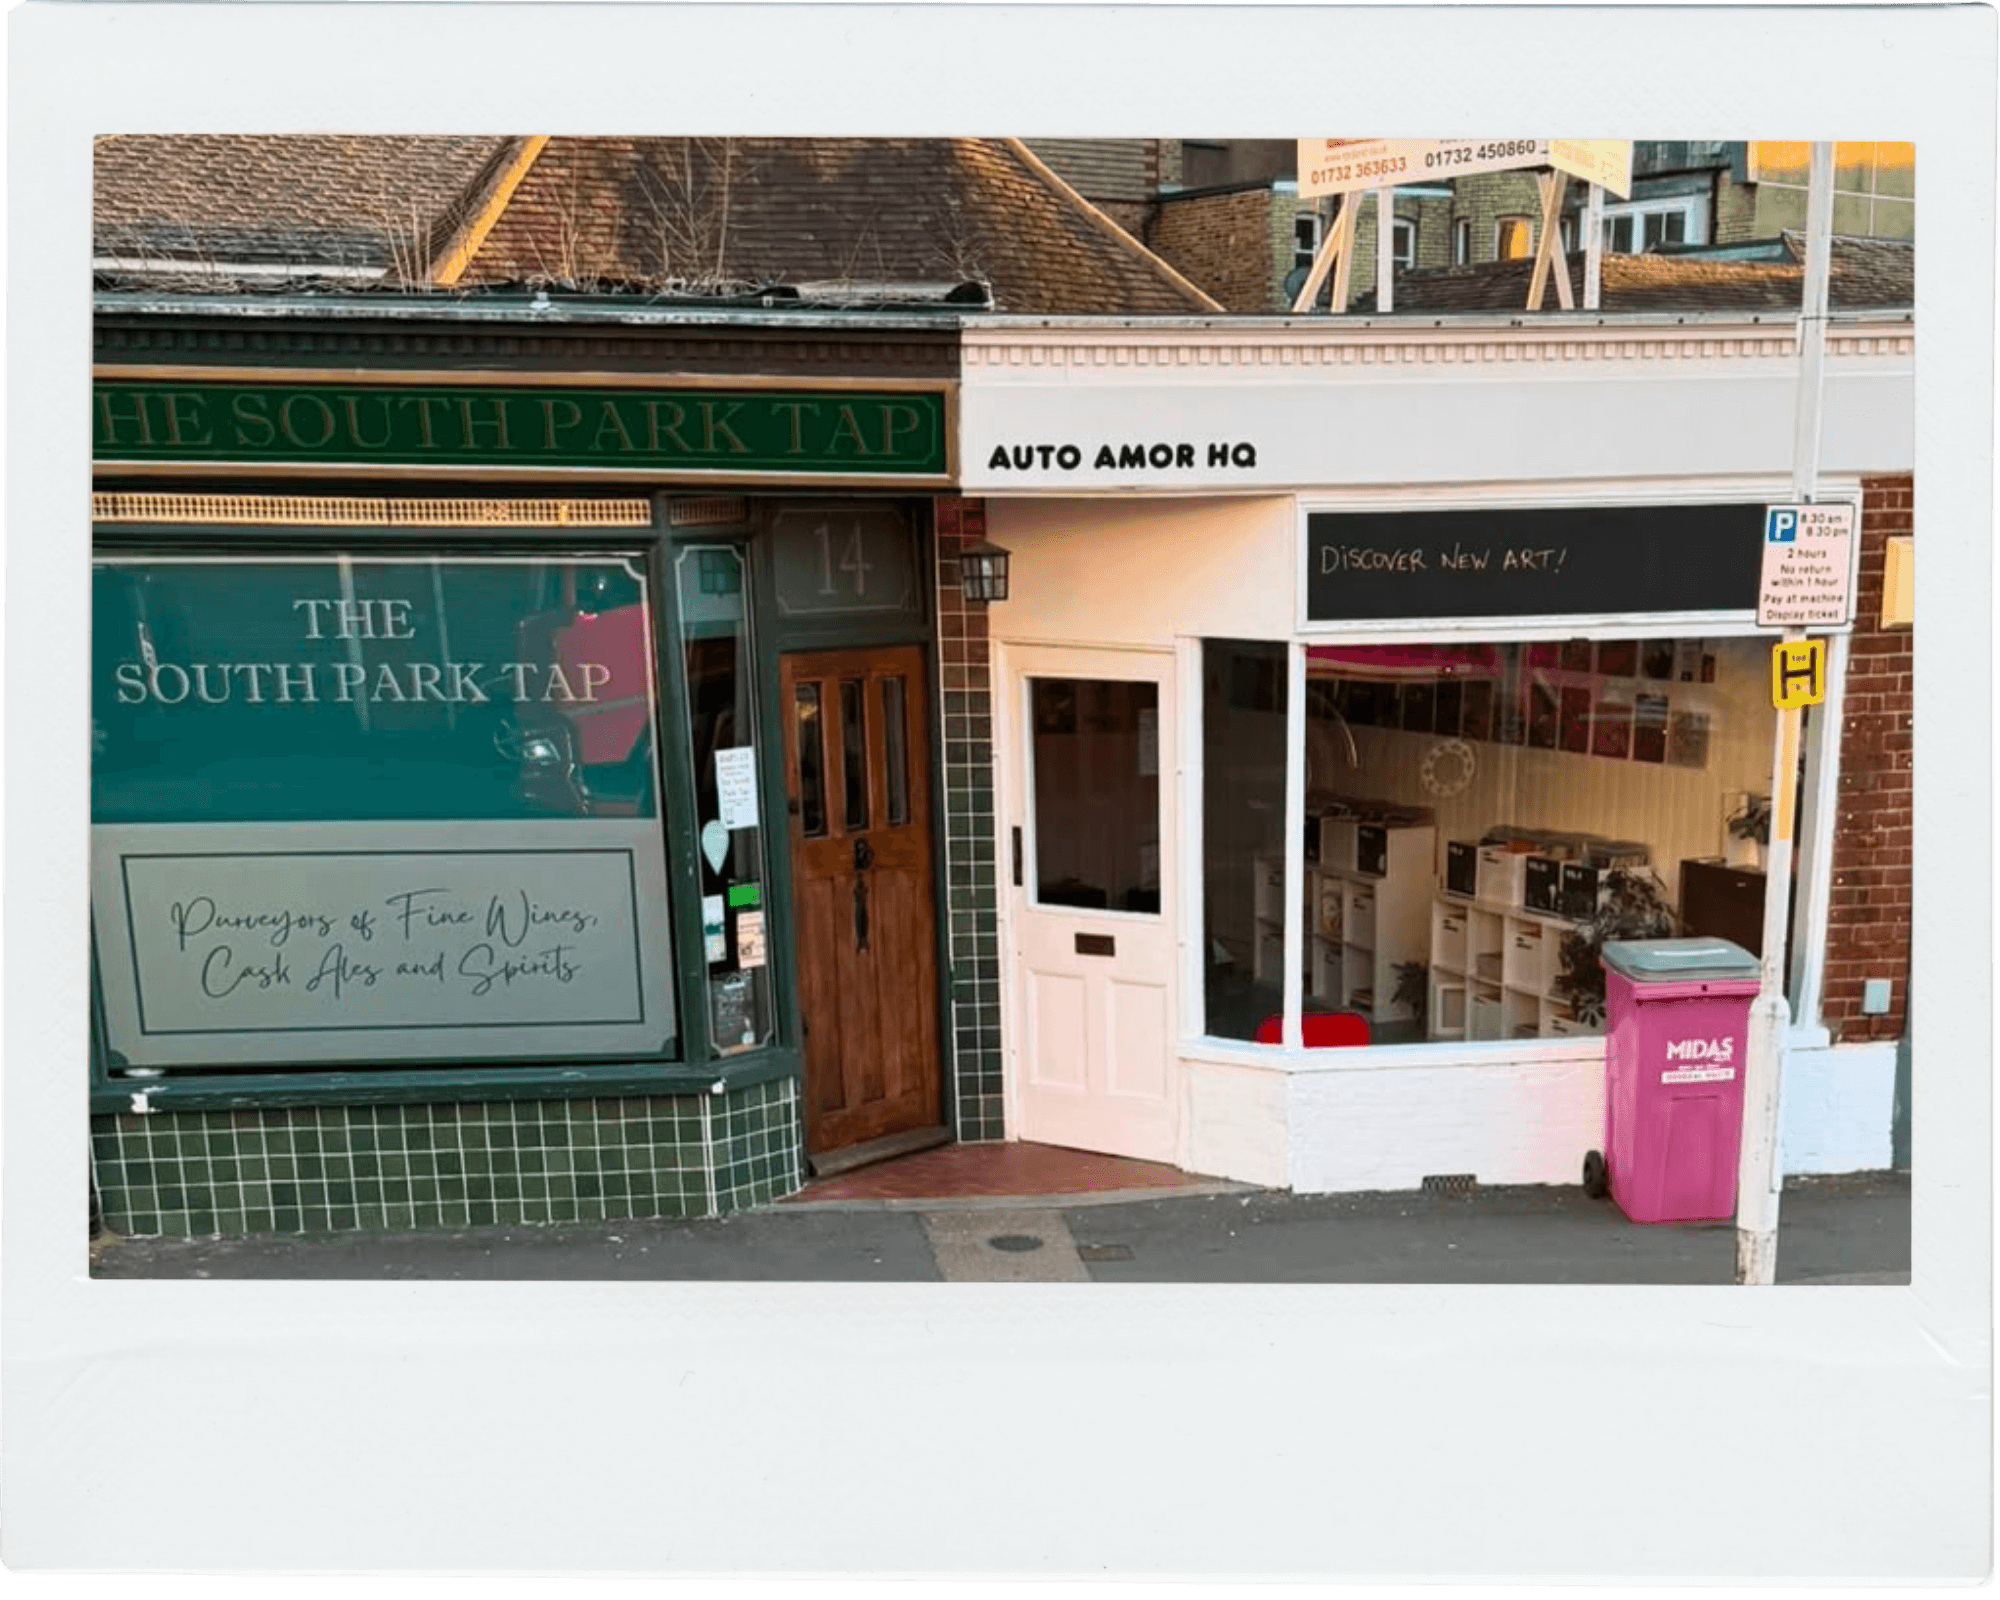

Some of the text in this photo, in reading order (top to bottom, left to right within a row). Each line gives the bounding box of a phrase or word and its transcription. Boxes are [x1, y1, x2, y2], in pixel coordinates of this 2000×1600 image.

[1311, 156, 1406, 185] 01732 363633
[1425, 147, 1472, 168] 01732
[95, 392, 924, 457] HE SOUTH PARK TAP
[988, 442, 1257, 470] AUTO AMOR HQ
[1775, 512, 1794, 540] P
[1801, 513, 1825, 524] 830
[1806, 526, 1831, 537] 830
[812, 523, 871, 595] 14
[1441, 542, 1490, 571] NEW
[1503, 547, 1567, 574] ART!
[1787, 548, 1826, 559] 2 hours
[1771, 577, 1803, 587] within
[1814, 577, 1838, 587] hour
[1780, 564, 1832, 574] No return
[1763, 593, 1843, 605] Pay at machine
[293, 599, 417, 640] THE
[1766, 609, 1839, 620] Display ticket
[115, 662, 613, 704] SOUTH PARK TAP
[1780, 646, 1817, 700] H
[170, 888, 599, 952] Purveyors of Fine Wines,
[201, 943, 581, 1000] Cask Ales and Spirits
[1666, 1037, 1734, 1060] MIDAS
